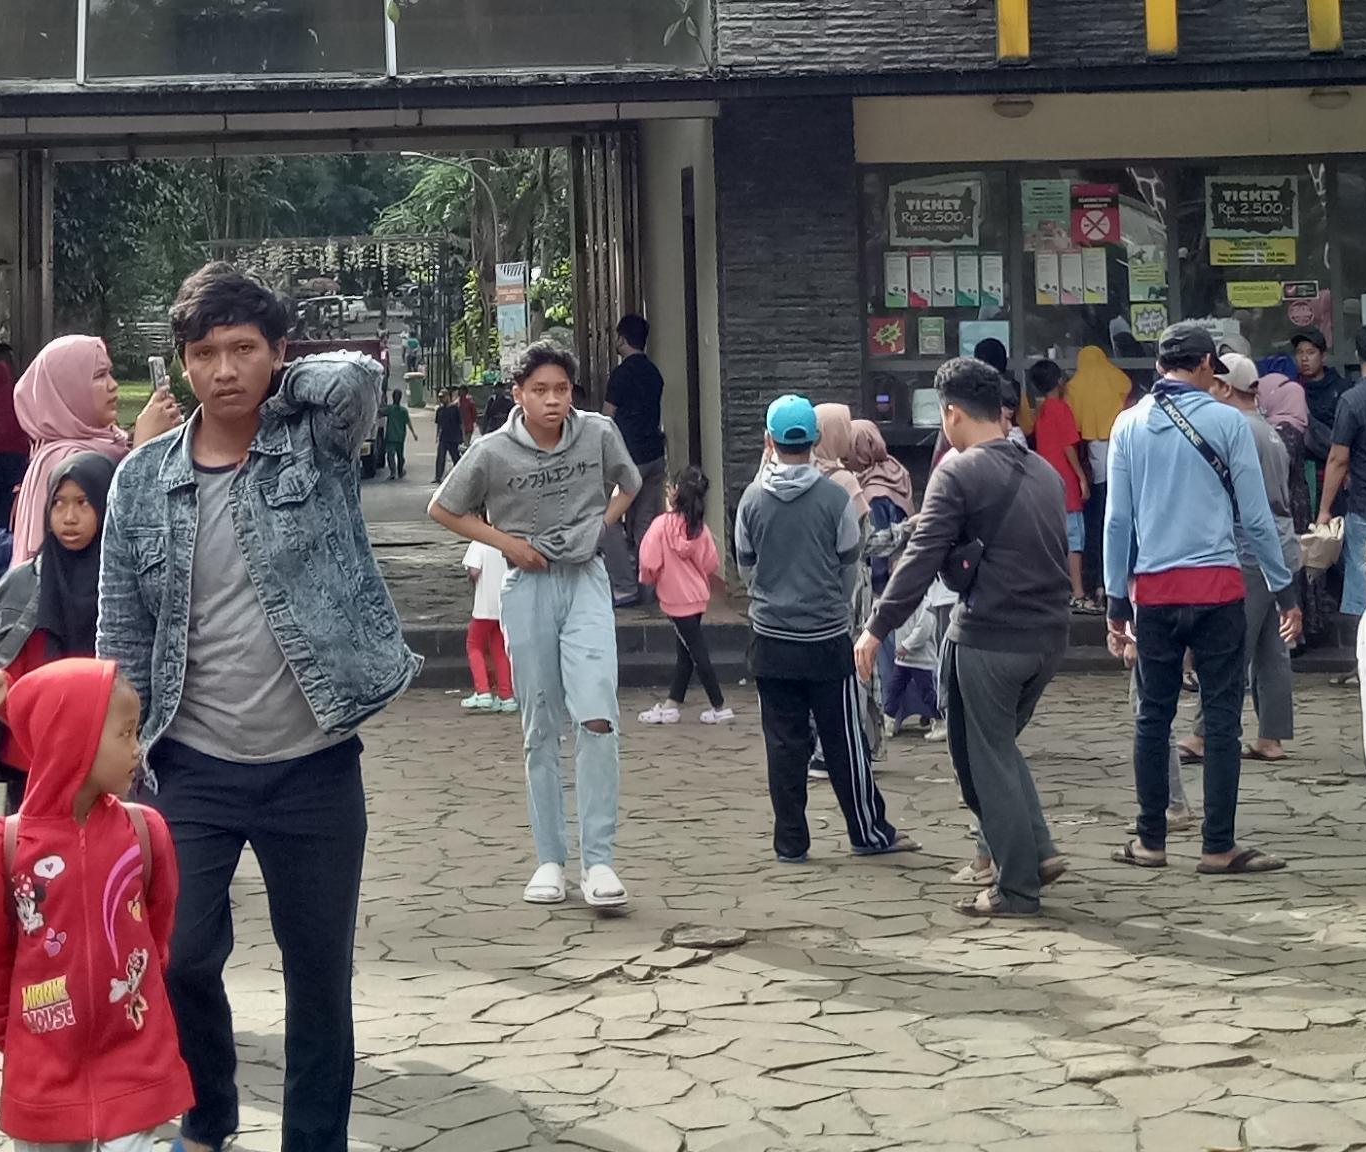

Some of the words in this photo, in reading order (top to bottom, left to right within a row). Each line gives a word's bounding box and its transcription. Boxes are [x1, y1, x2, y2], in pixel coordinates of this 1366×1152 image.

[1222, 190, 1281, 202] TICKET
[906, 199, 961, 210] TICKET
[22, 999, 77, 1034] MOUSE
